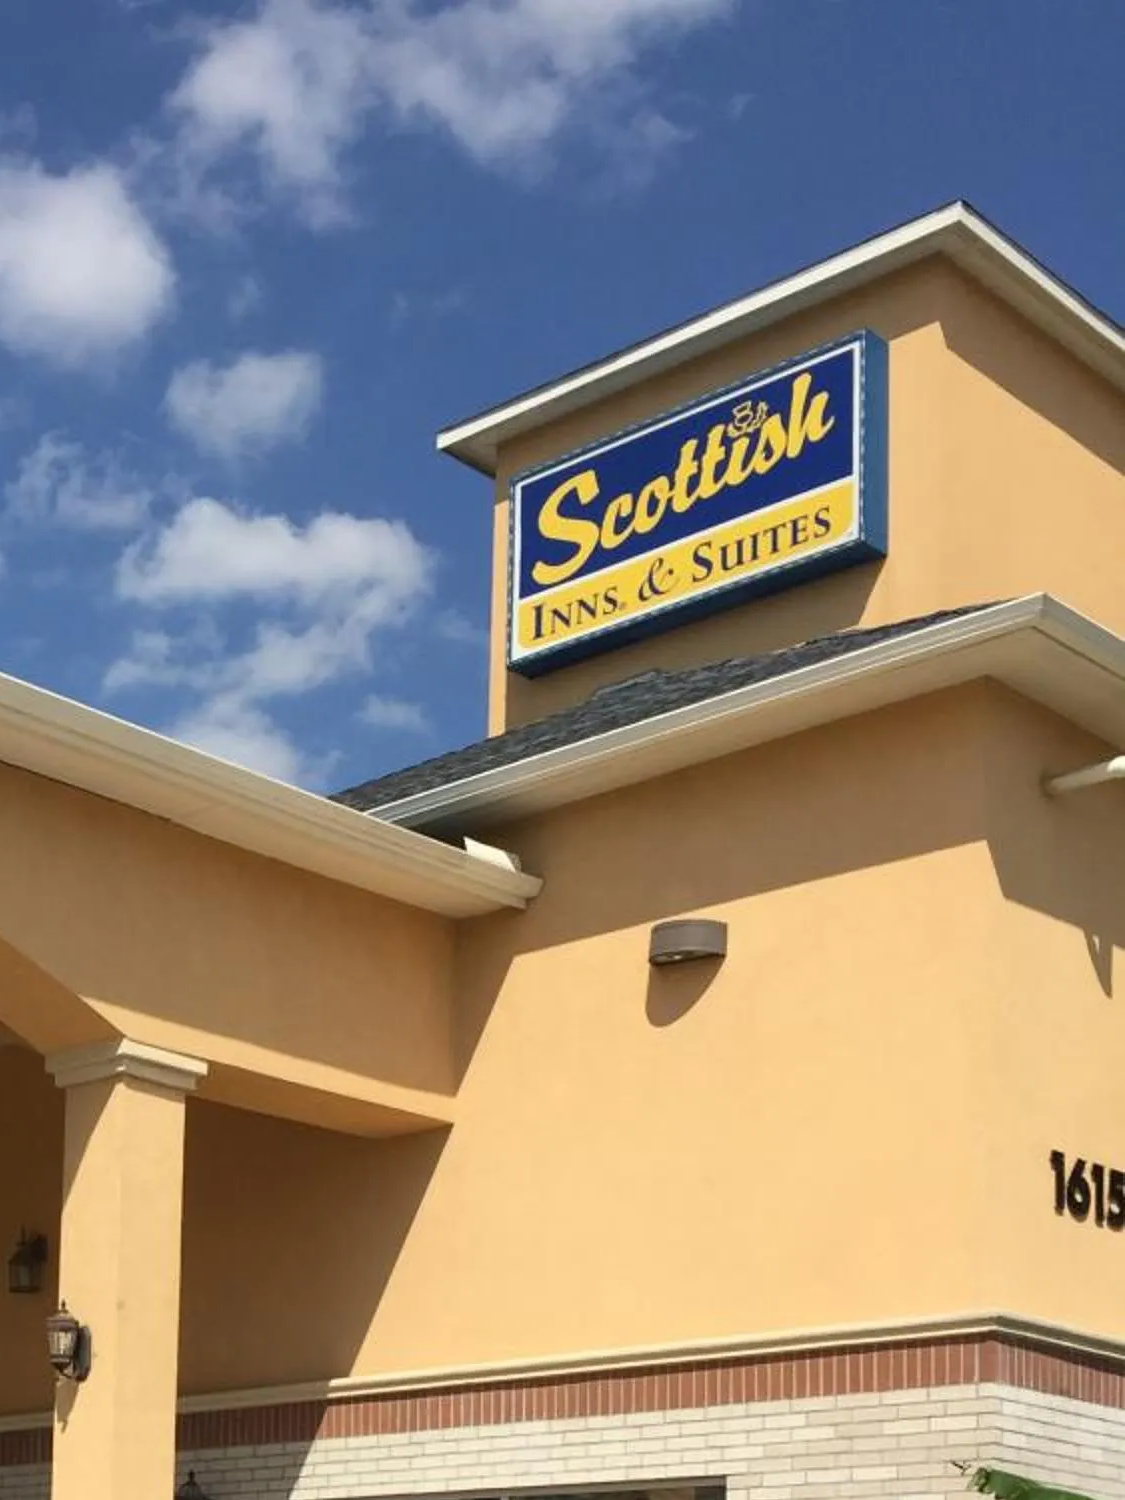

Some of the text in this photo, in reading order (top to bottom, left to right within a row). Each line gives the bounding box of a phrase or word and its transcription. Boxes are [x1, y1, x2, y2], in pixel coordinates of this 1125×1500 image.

[531, 372, 835, 586] Scottish
[532, 506, 833, 641] INNS & SUITES
